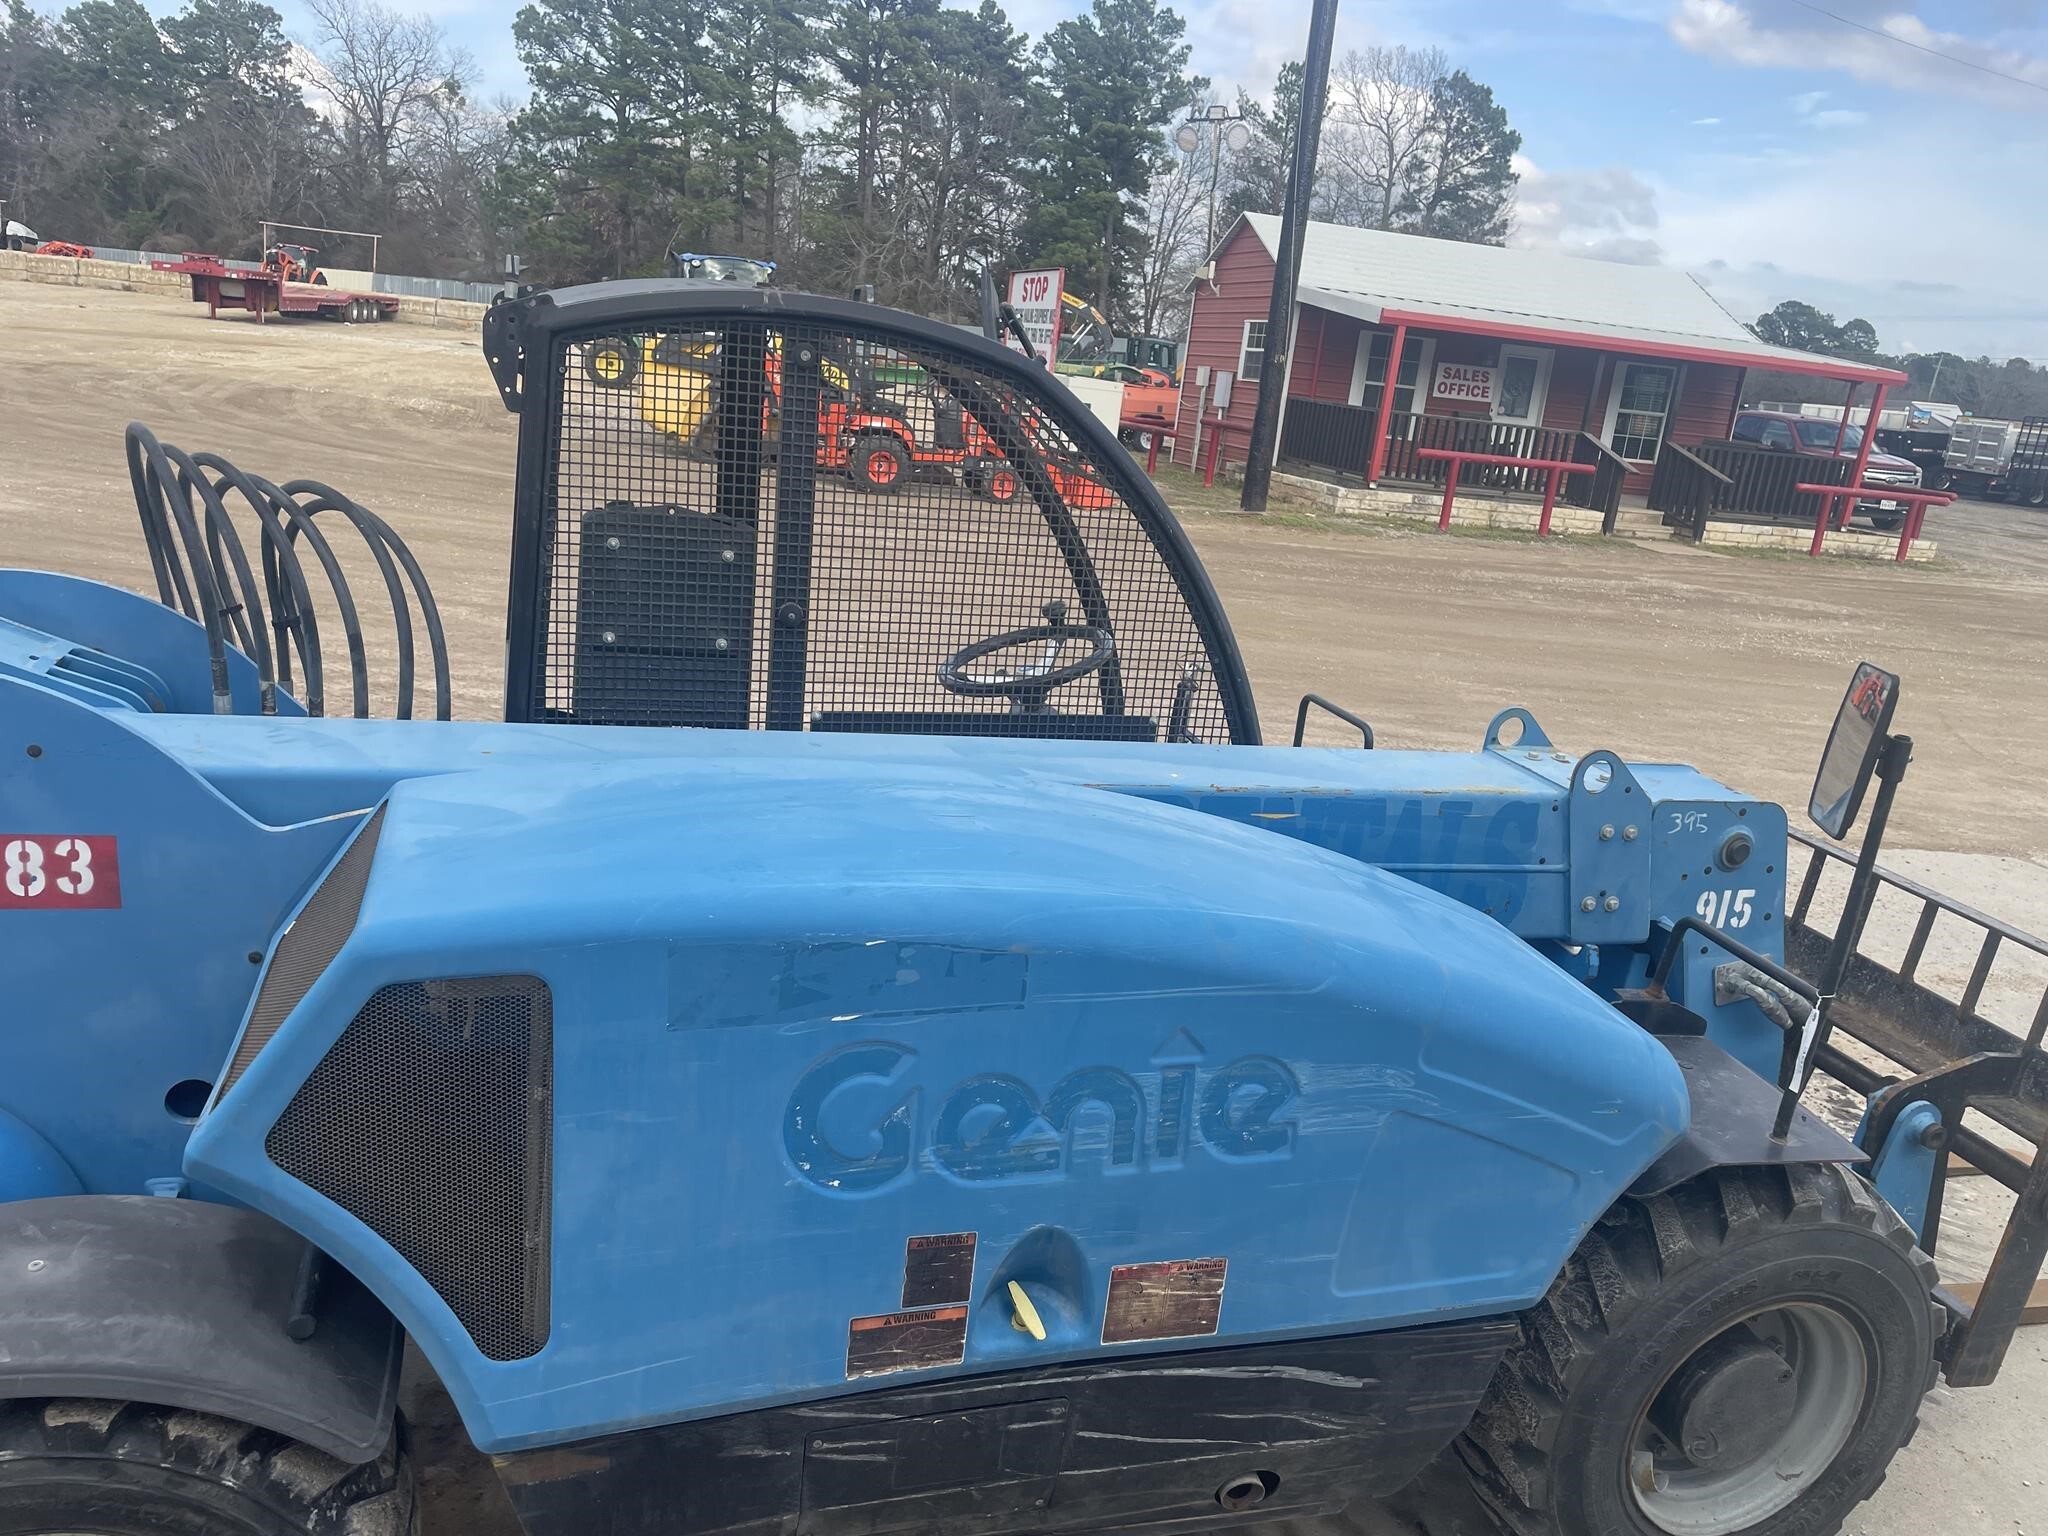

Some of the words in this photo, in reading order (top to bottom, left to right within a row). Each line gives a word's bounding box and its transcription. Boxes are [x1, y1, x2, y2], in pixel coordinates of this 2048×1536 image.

[1021, 276, 1049, 303] STOP
[1442, 366, 1490, 384] SALES
[1437, 381, 1490, 398] OFFICE
[1667, 811, 1709, 834] 395
[4, 839, 95, 897] 83
[1695, 889, 1756, 929] 915
[783, 1030, 1299, 1197] Genie
[927, 1235, 969, 1249] WARNING
[1186, 1260, 1223, 1271] WARNING
[893, 1311, 937, 1325] WARNING
